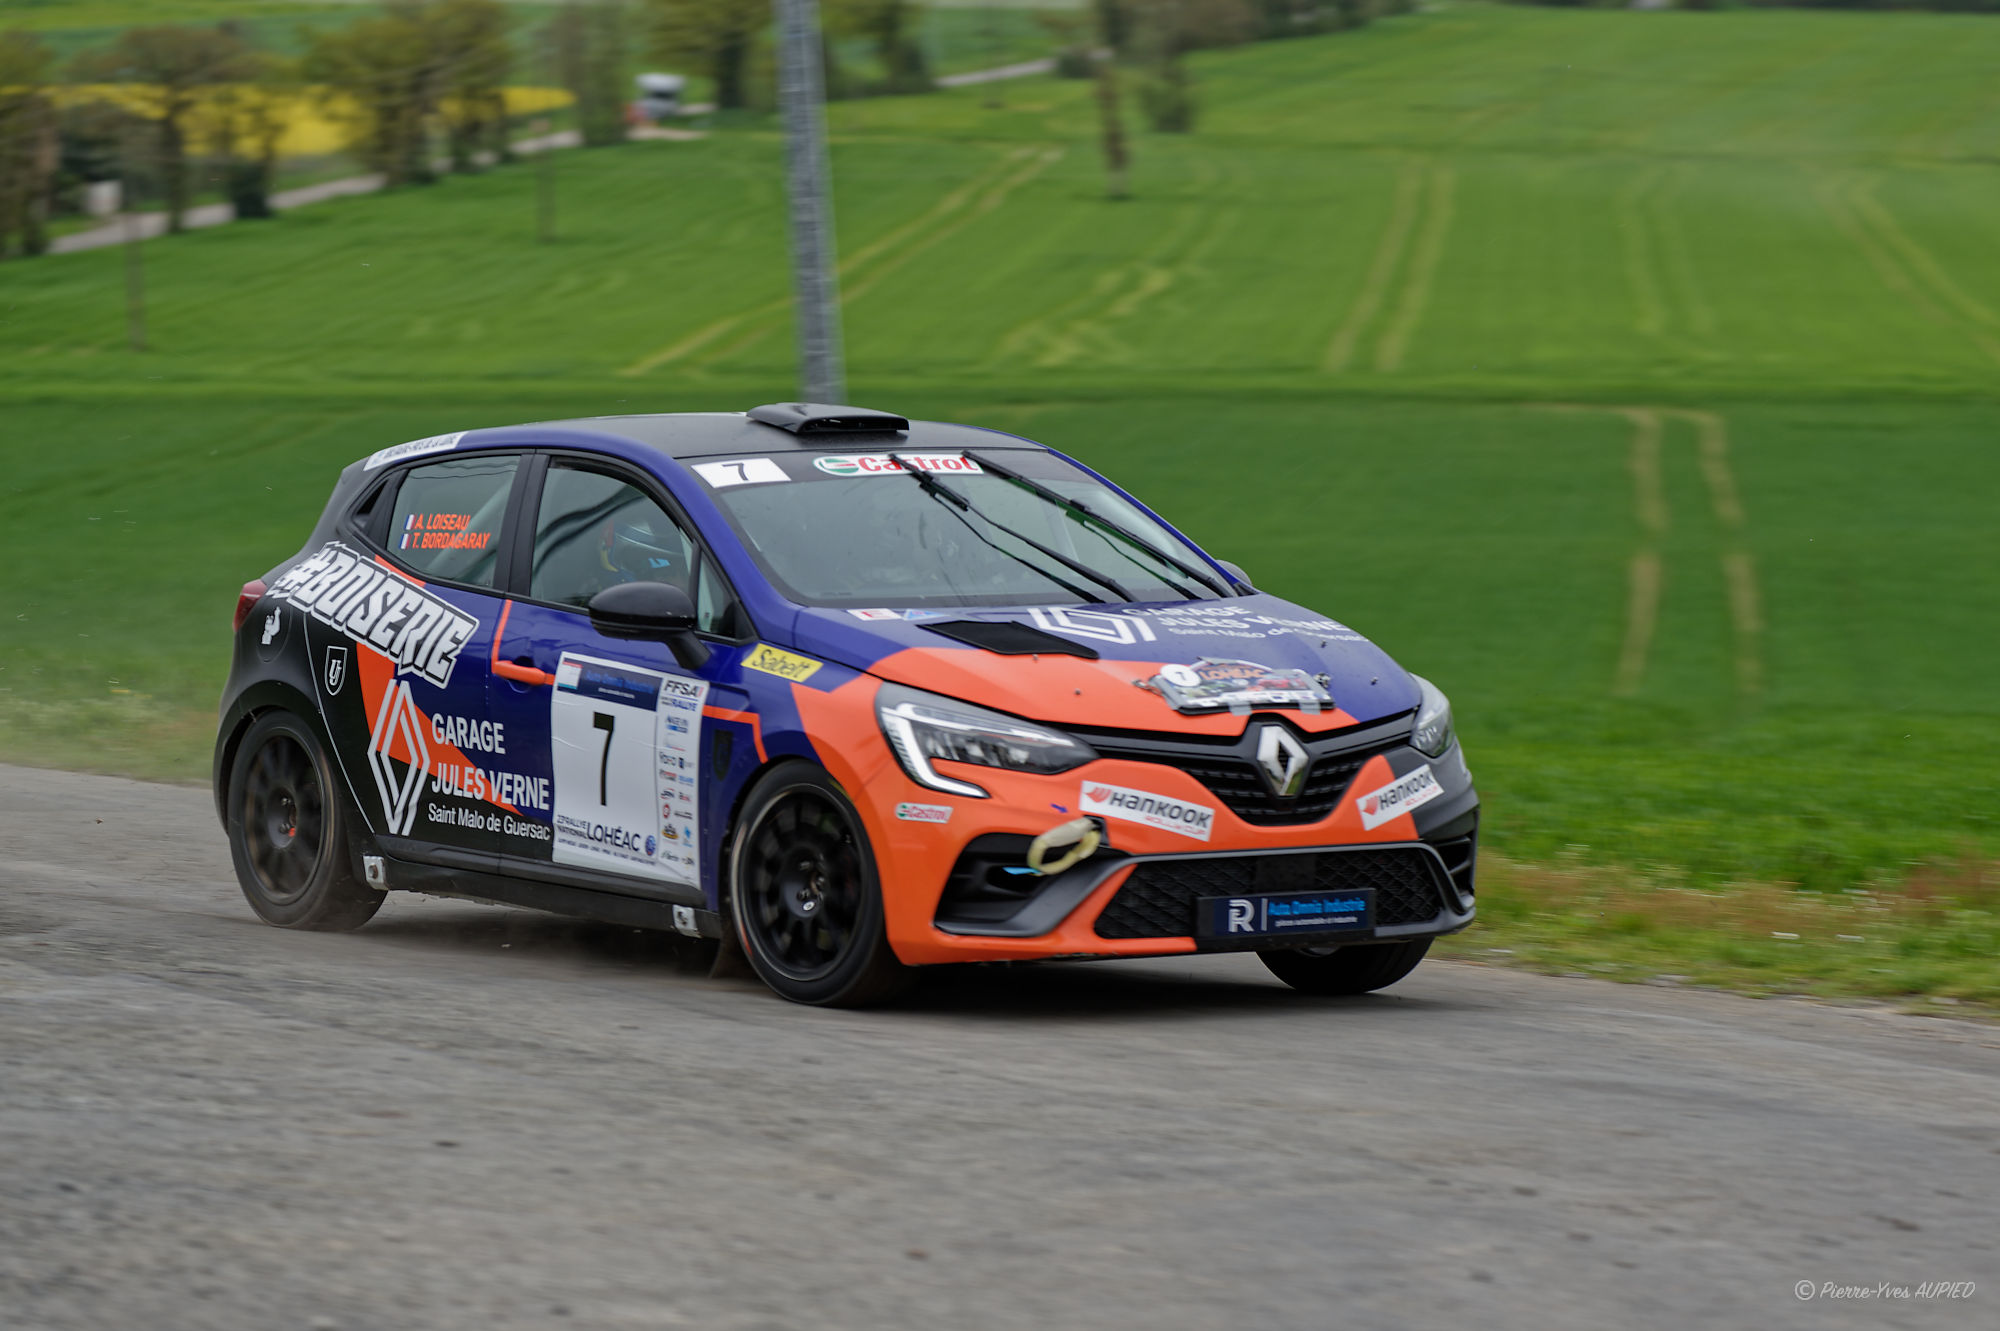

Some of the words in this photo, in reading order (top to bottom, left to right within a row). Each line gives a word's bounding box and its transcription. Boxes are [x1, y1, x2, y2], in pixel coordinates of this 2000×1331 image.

[722, 462, 748, 481] 7
[414, 513, 424, 530] A.
[426, 513, 471, 530] LOISEAU
[412, 532, 421, 549] T.
[421, 532, 491, 549] BORDAGARAY
[265, 542, 479, 689] #BOISERIE
[752, 648, 810, 679] Sabelt
[664, 680, 698, 698] FFSA
[431, 712, 506, 755] GARAGE
[593, 711, 615, 806] 7
[431, 762, 486, 801] JULES
[489, 770, 550, 811] VERNE
[428, 802, 457, 825] Saint
[458, 807, 485, 830] Malo
[486, 812, 502, 832] de
[503, 815, 551, 841] Guersac
[586, 821, 641, 852] LOHÉAC
